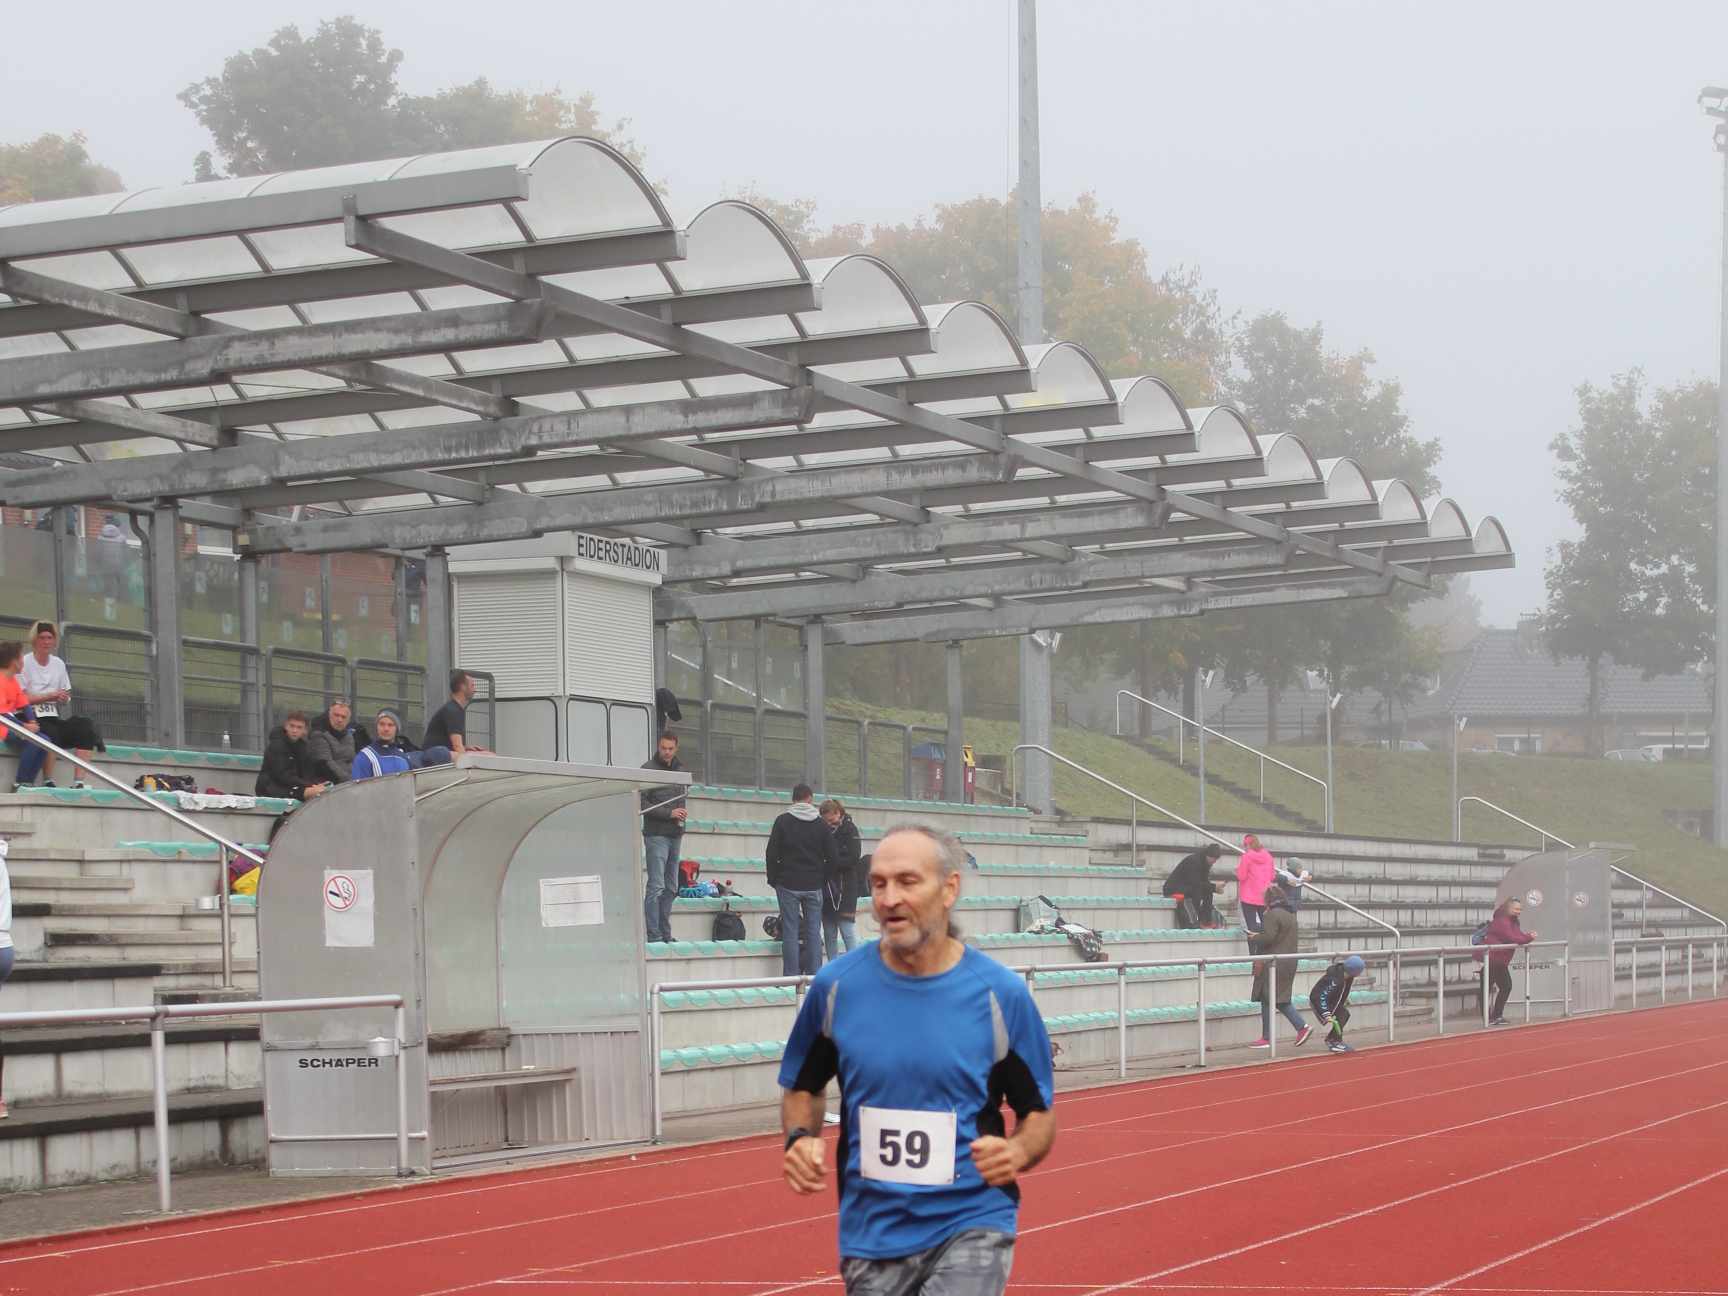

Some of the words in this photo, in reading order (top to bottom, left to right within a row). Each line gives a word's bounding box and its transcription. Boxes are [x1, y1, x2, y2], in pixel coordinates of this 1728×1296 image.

[577, 534, 660, 571] EIDERSTADION
[298, 1057, 379, 1068] SCHÄPER
[879, 1128, 931, 1169] 59
